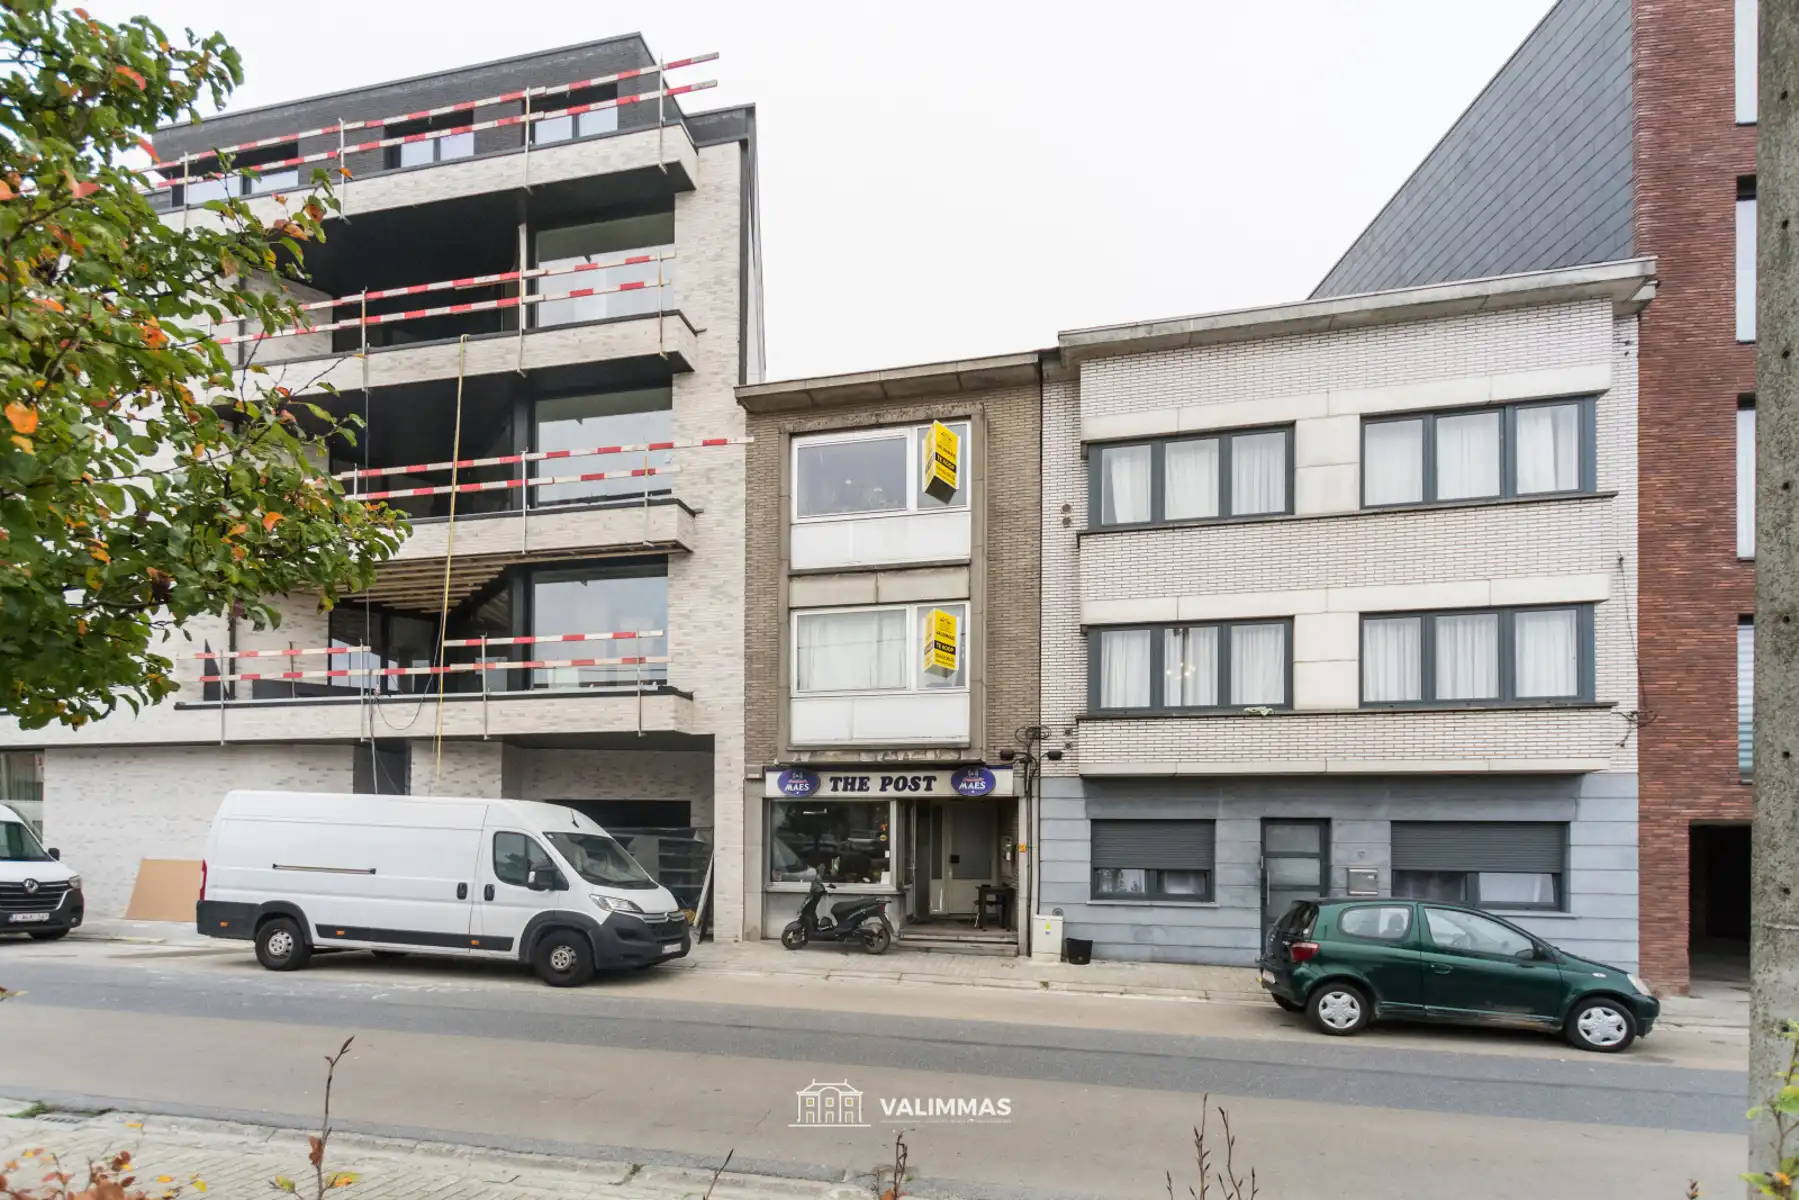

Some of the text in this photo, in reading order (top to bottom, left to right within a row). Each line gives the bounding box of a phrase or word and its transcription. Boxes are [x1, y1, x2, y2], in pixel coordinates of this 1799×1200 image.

[785, 783, 810, 792] MAES
[829, 776, 937, 792] THE POST
[958, 781, 986, 790] MAES
